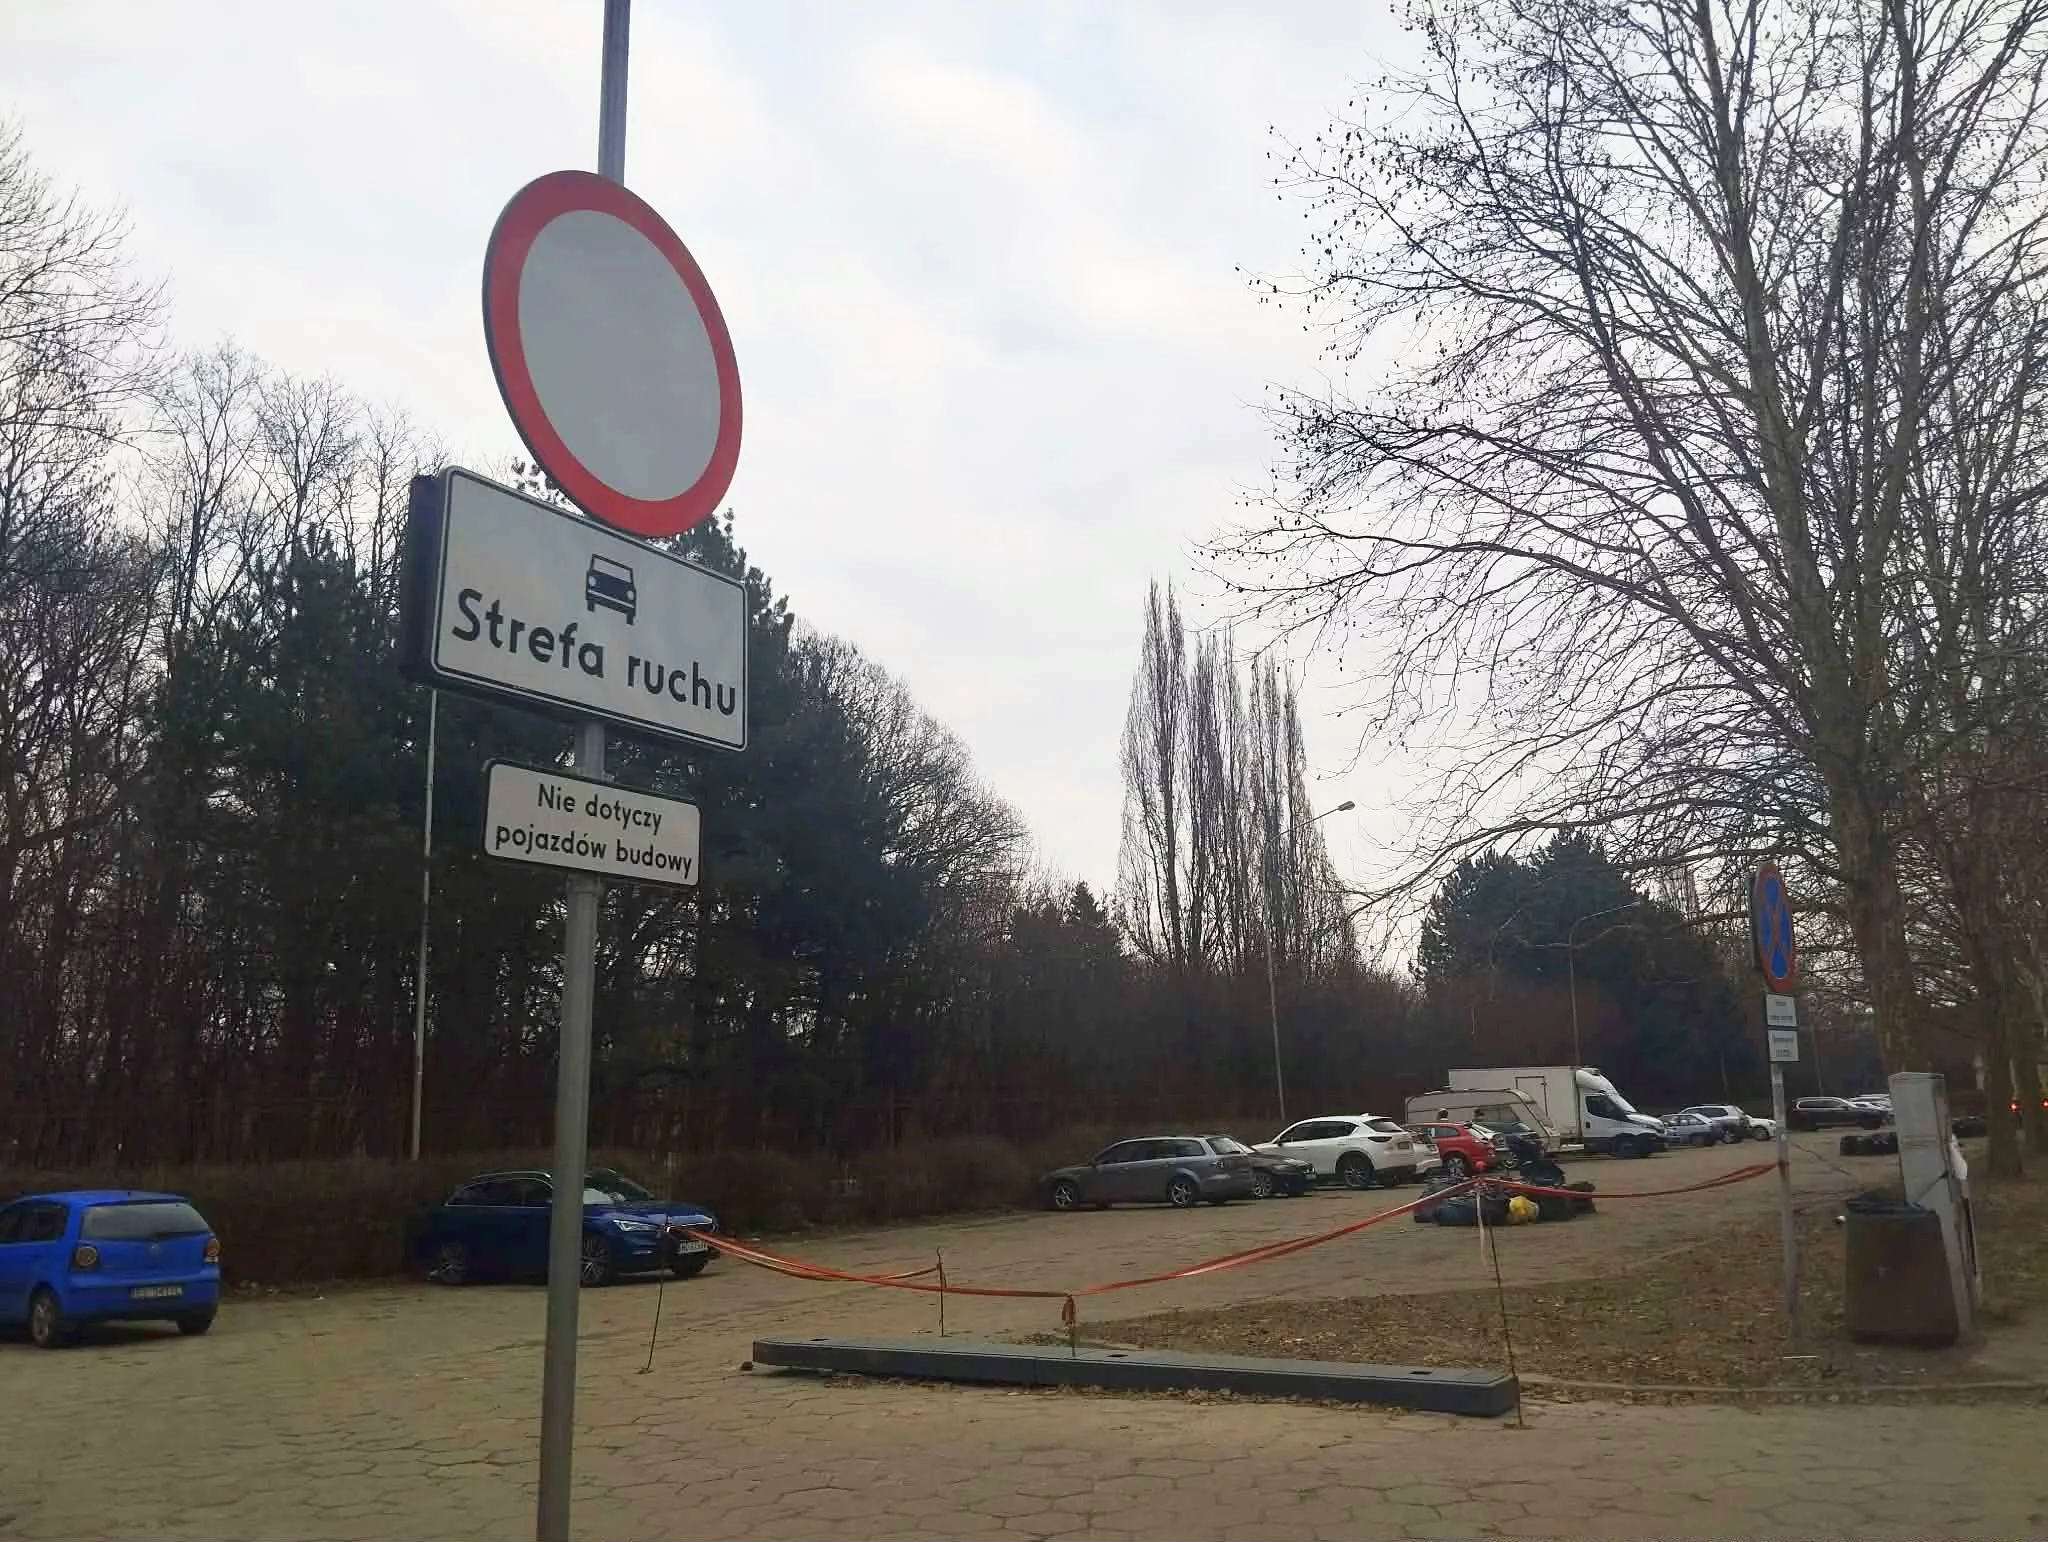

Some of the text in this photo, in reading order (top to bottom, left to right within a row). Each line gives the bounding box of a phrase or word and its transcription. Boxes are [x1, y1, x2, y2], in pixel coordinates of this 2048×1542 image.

[452, 587, 735, 716] Strefa ruchu
[537, 784, 662, 835] Nie dotyczy
[495, 824, 692, 879] pojazdów budowy
